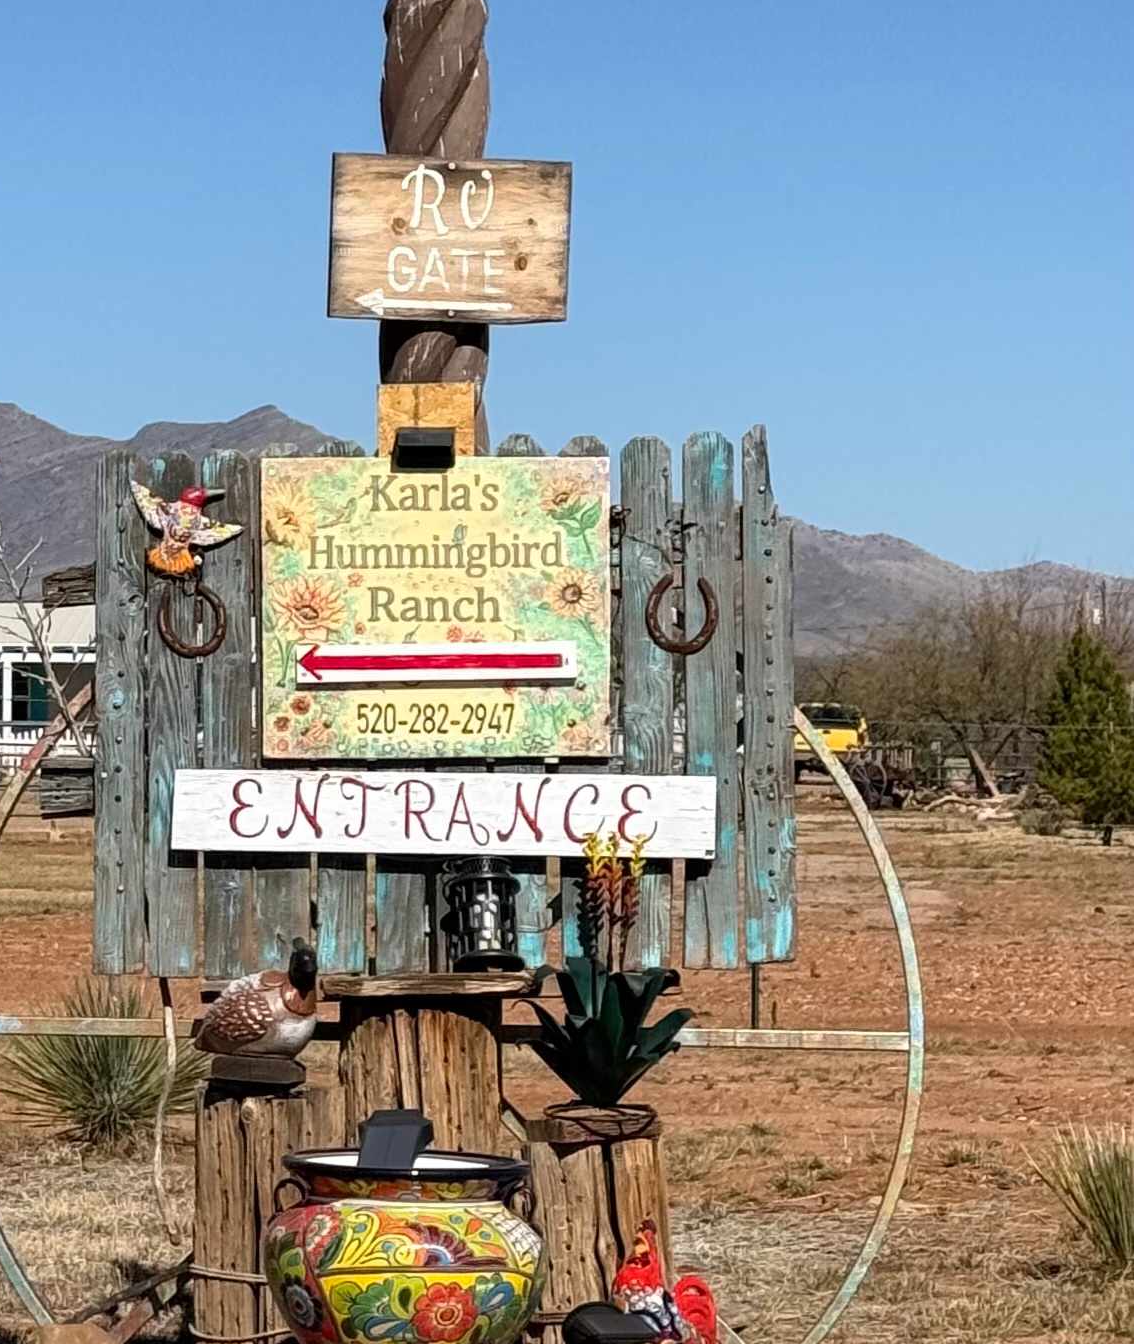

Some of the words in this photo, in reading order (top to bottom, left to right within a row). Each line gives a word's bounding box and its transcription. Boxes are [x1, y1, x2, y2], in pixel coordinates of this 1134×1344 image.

[401, 164, 494, 235] RV
[387, 246, 506, 293] GATE
[370, 474, 499, 512] Karla's
[307, 532, 564, 577] Hummingbird
[368, 586, 502, 623] Ranch
[356, 703, 515, 735] 520-282-2947
[229, 774, 657, 846] ENTRANCE
